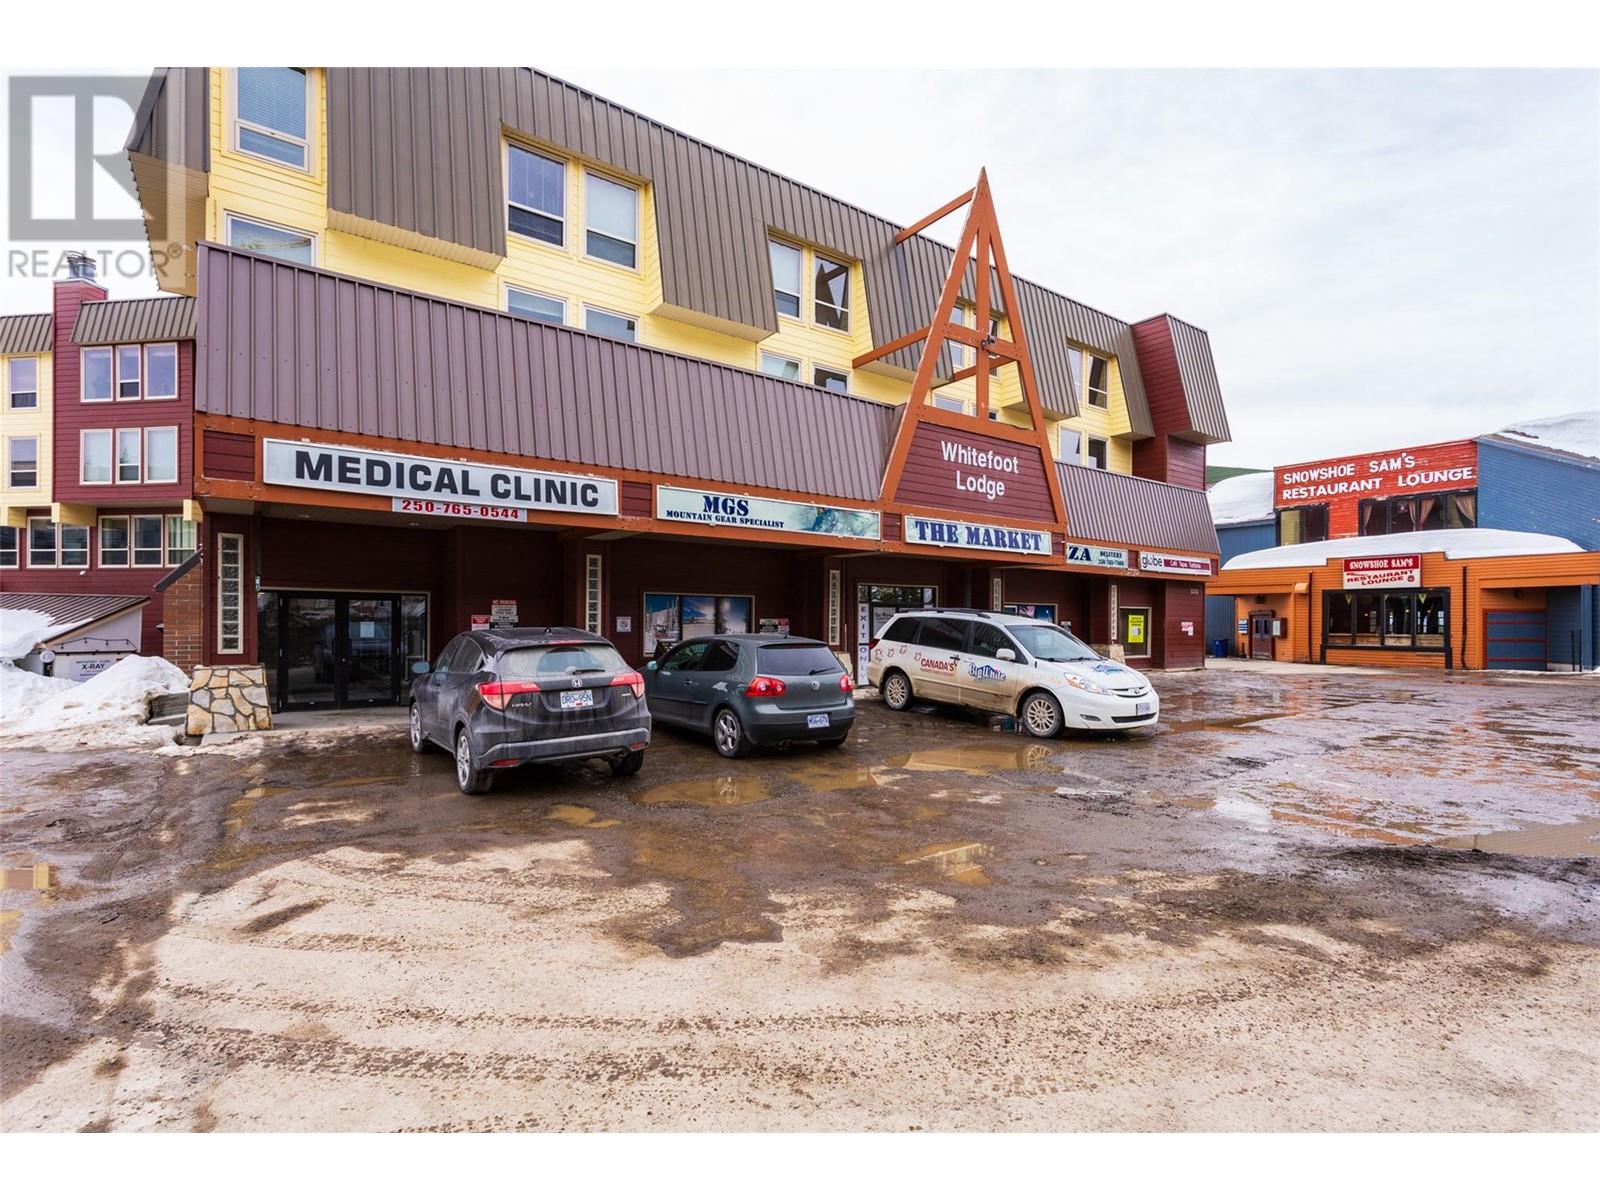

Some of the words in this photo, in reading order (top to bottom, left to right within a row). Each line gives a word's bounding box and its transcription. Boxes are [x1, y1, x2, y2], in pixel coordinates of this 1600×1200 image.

[941, 441, 1019, 474] Whitefoot
[295, 450, 481, 497] MEDICAL
[490, 473, 599, 507] CLINIC
[1283, 463, 1355, 485] SNOWSHOE
[1368, 452, 1416, 473] SAM'S
[956, 470, 1005, 500] Lodge
[1282, 477, 1382, 500] RESTAURANT
[401, 499, 519, 520] 250-765-0544
[702, 495, 750, 516] MGS
[666, 509, 713, 522] MOUNTAIN
[715, 514, 738, 525] GEAR
[739, 518, 785, 529] SPECIALIST
[915, 520, 959, 544] THE
[965, 526, 1042, 551] MARKET
[1068, 546, 1092, 562] ZA
[1141, 554, 1163, 568] globe
[1349, 559, 1389, 570] SNOWSHOE
[1391, 558, 1414, 567] SAM'S
[1346, 569, 1415, 583] RESTAURANT
[1361, 576, 1405, 586] LOUNGE
[920, 657, 956, 672] CANADA'S
